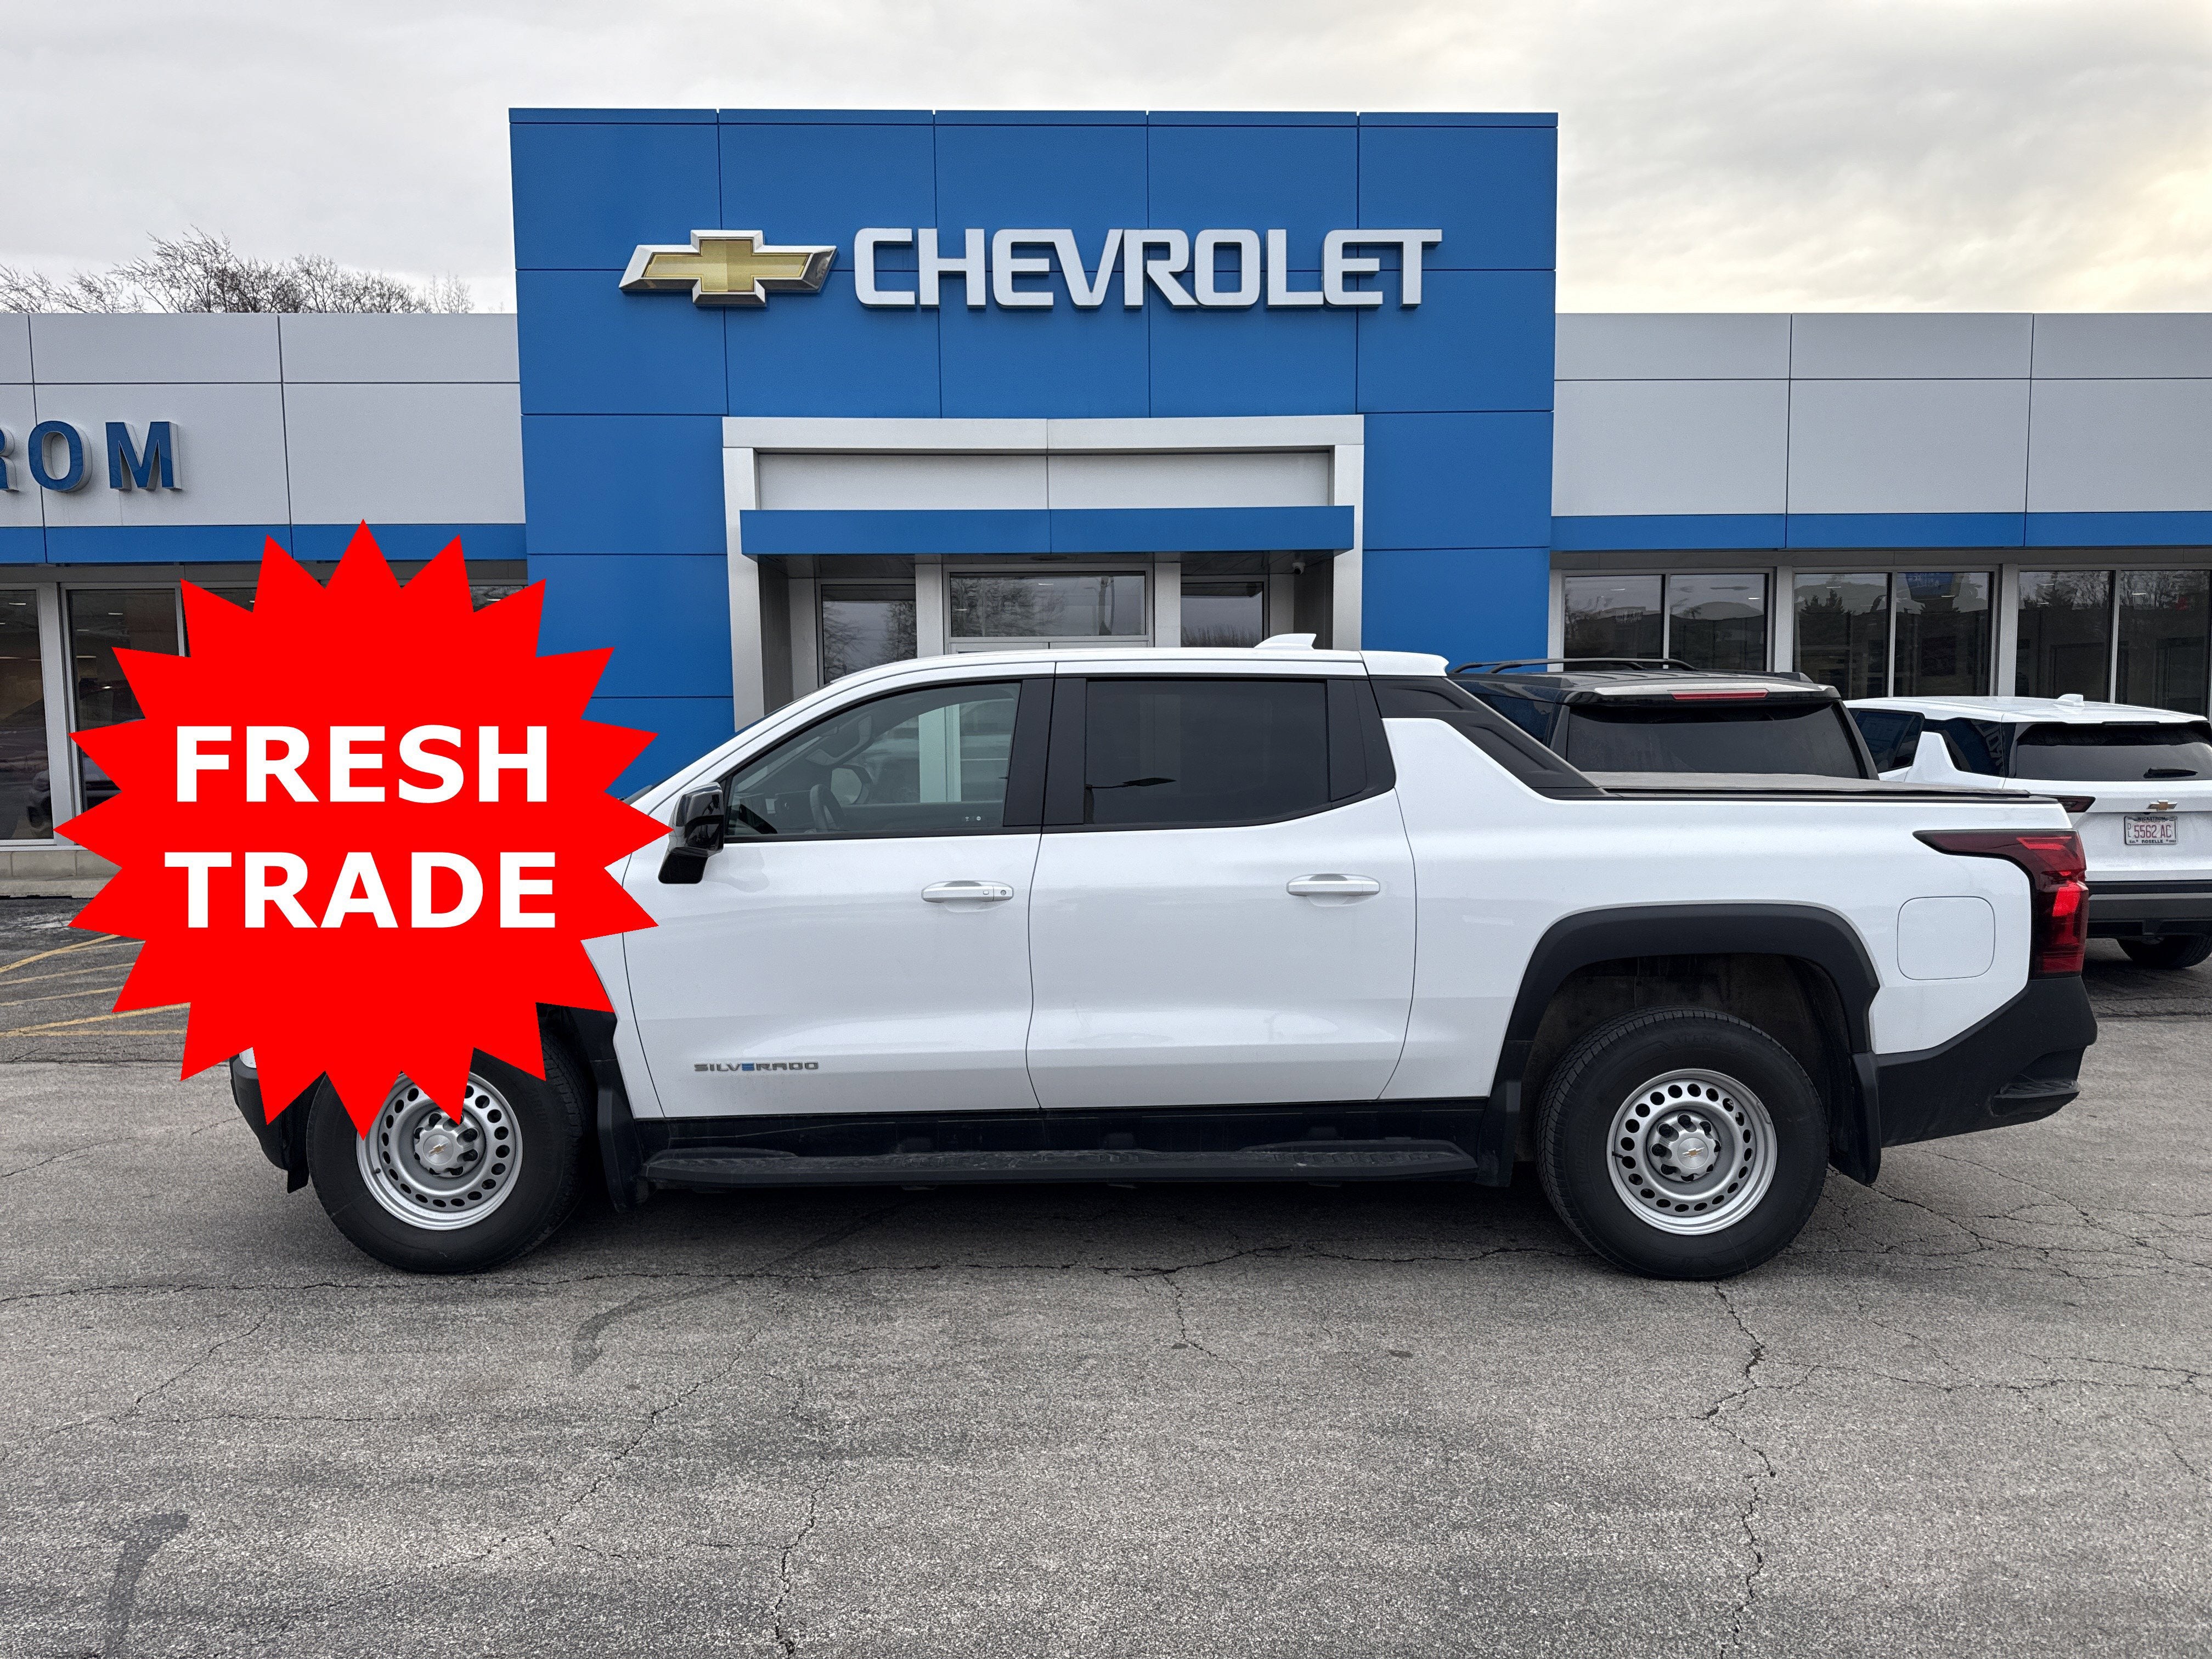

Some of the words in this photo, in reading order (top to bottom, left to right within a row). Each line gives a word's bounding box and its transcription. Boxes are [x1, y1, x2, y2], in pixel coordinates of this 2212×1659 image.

[854, 227, 1443, 309] CHEVROLET
[0, 420, 182, 492] OM
[2134, 825, 2157, 838] 5562
[2160, 825, 2171, 838] AC
[694, 1062, 819, 1071] SILVERADO
